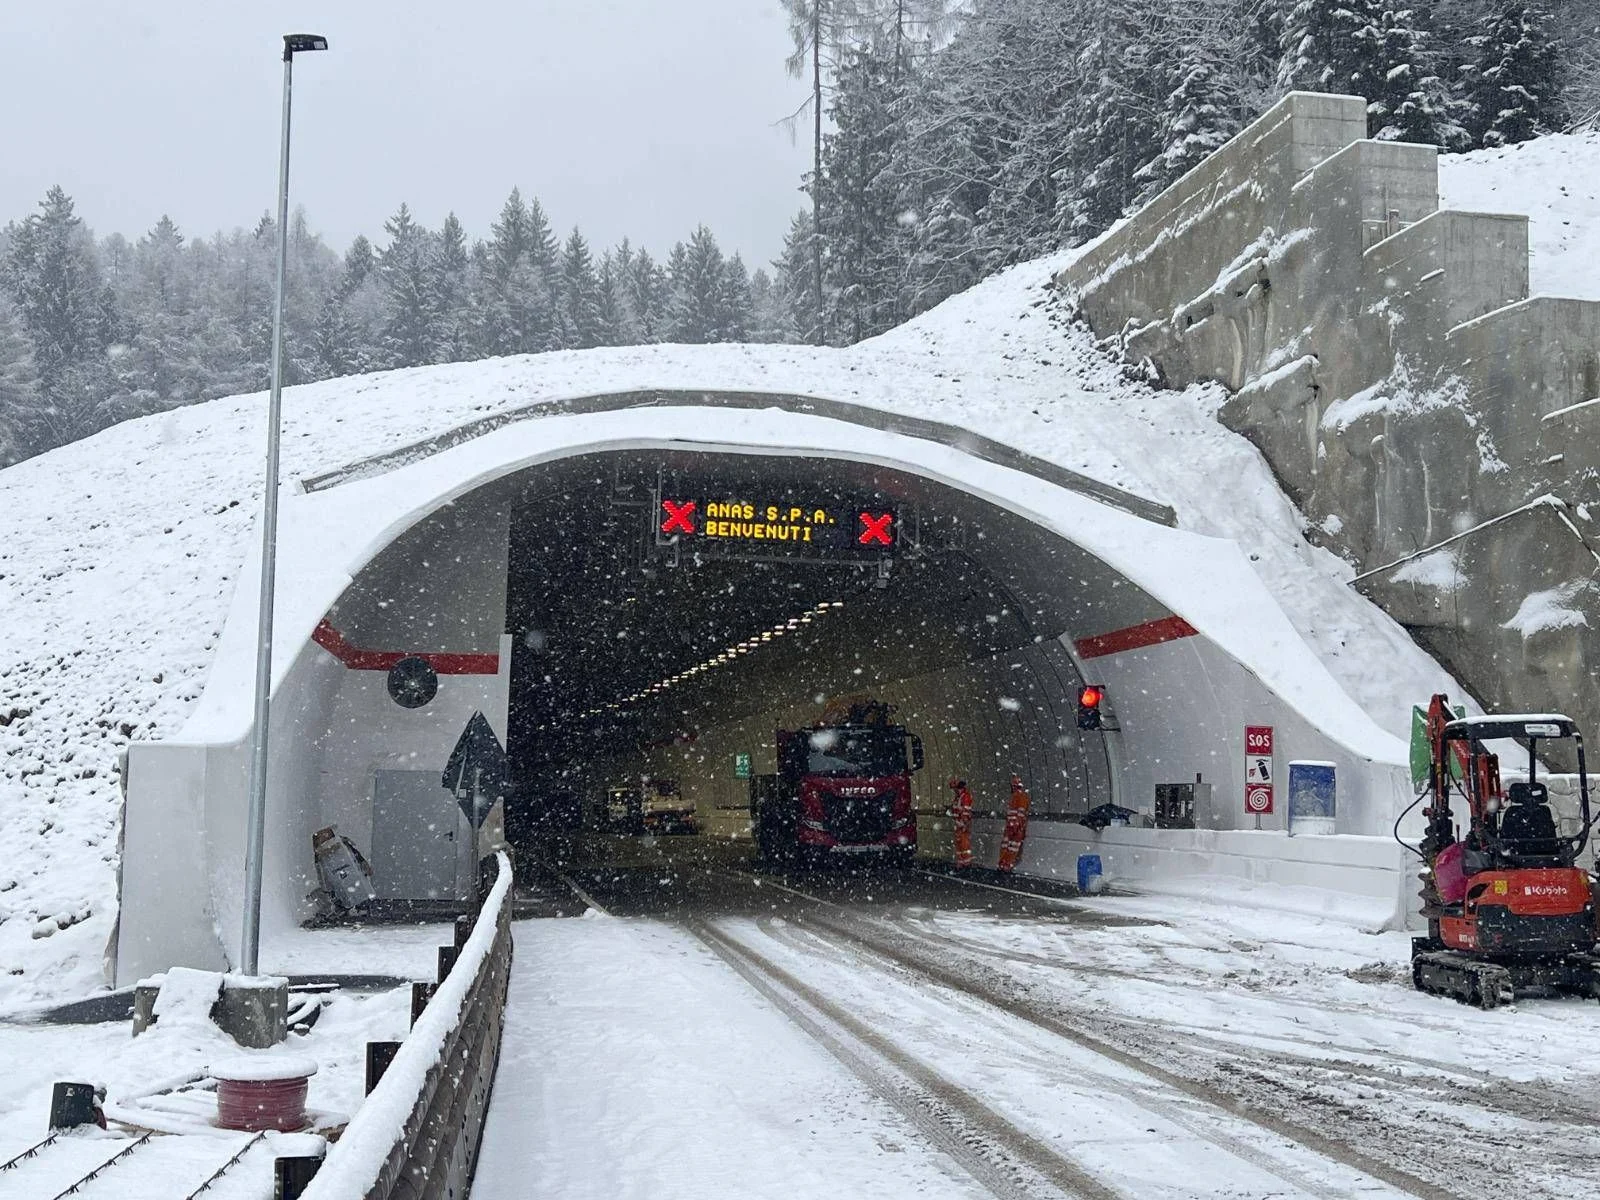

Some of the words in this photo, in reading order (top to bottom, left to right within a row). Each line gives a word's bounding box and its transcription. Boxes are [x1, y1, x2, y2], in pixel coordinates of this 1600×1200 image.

[706, 502, 754, 520] ANAS
[766, 506, 834, 524] S.P.A.
[706, 521, 811, 541] BENVENUTI
[1248, 734, 1270, 747] SOS
[1531, 885, 1568, 895] Kubota
